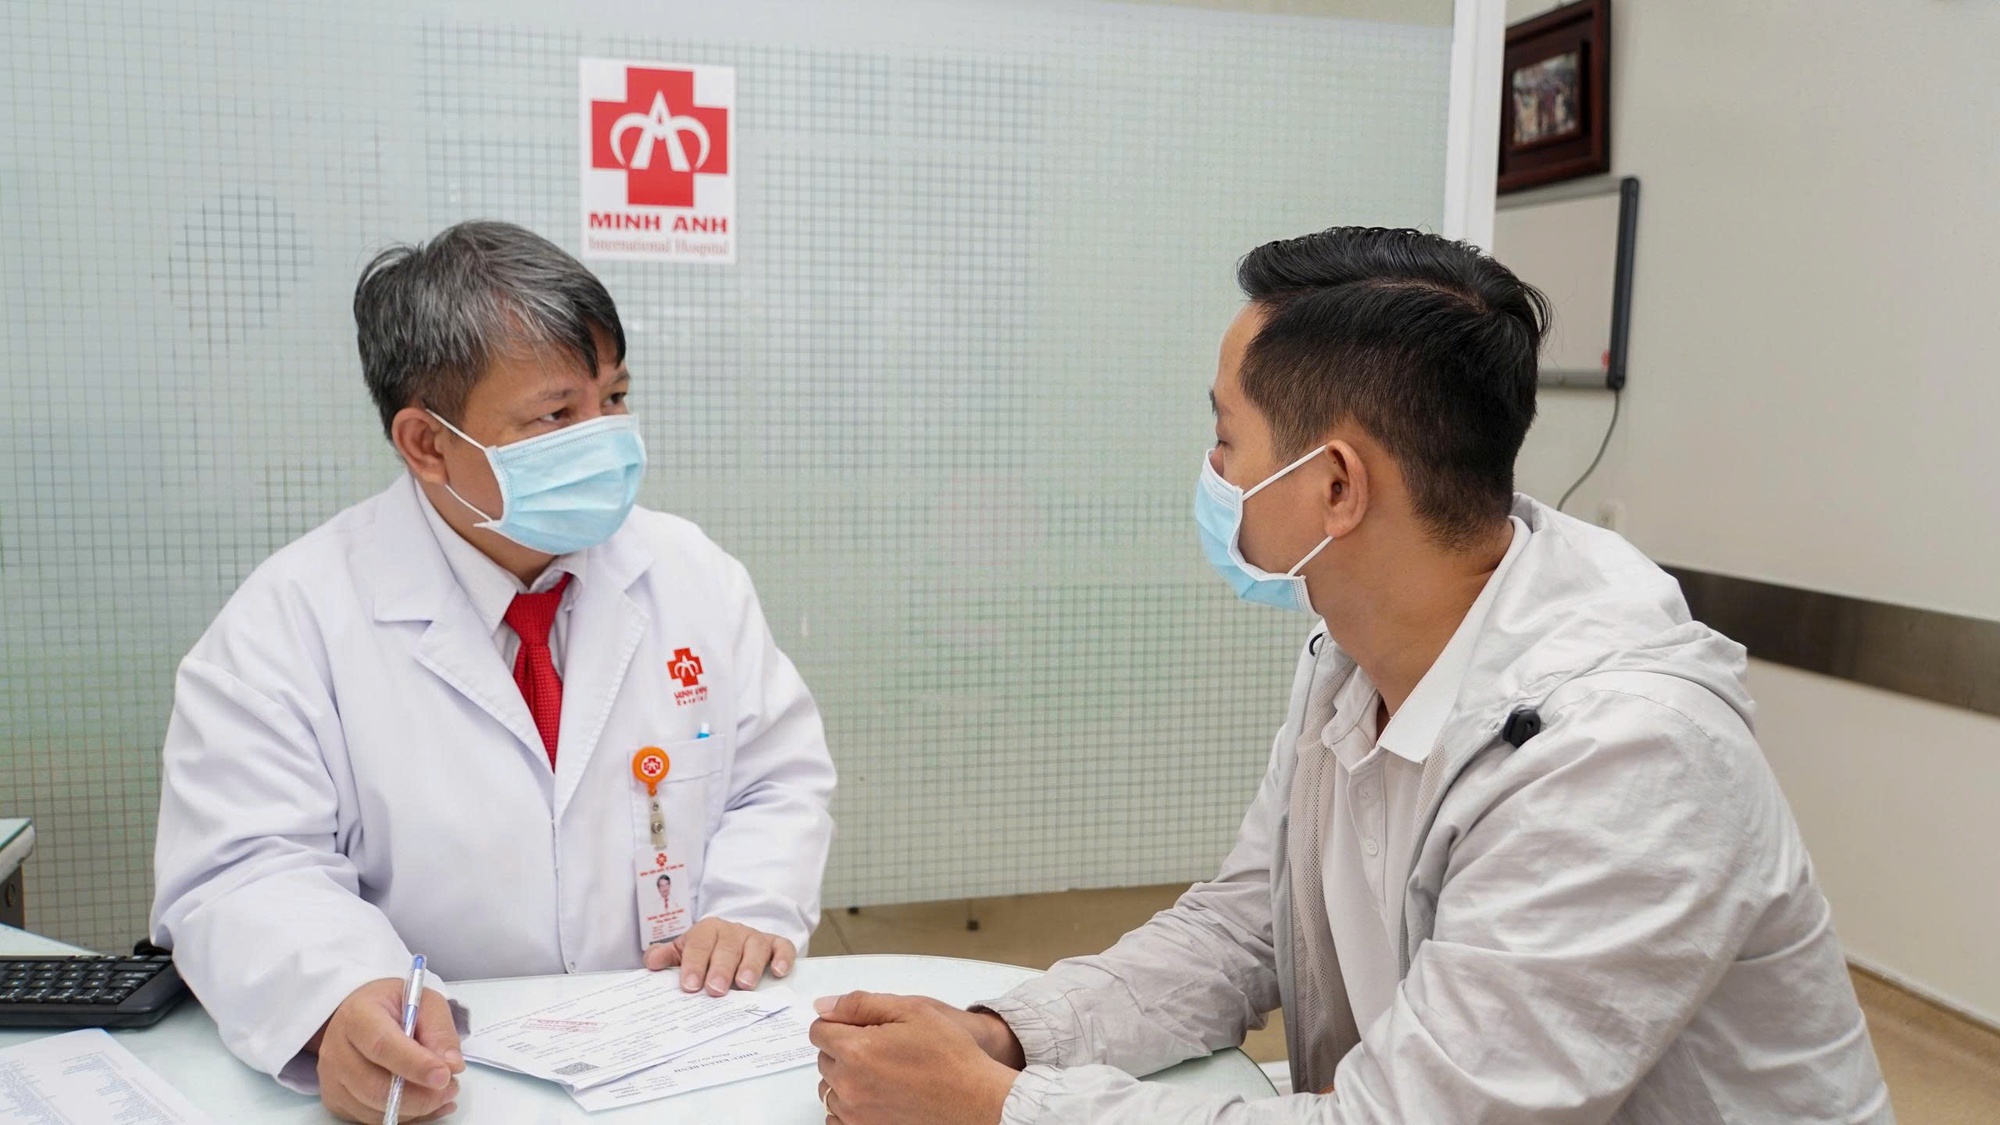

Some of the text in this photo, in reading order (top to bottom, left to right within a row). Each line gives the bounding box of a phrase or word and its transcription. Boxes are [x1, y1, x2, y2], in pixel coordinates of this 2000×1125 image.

[589, 212, 728, 233] MINH ANH
[588, 236, 729, 256] International Hospital
